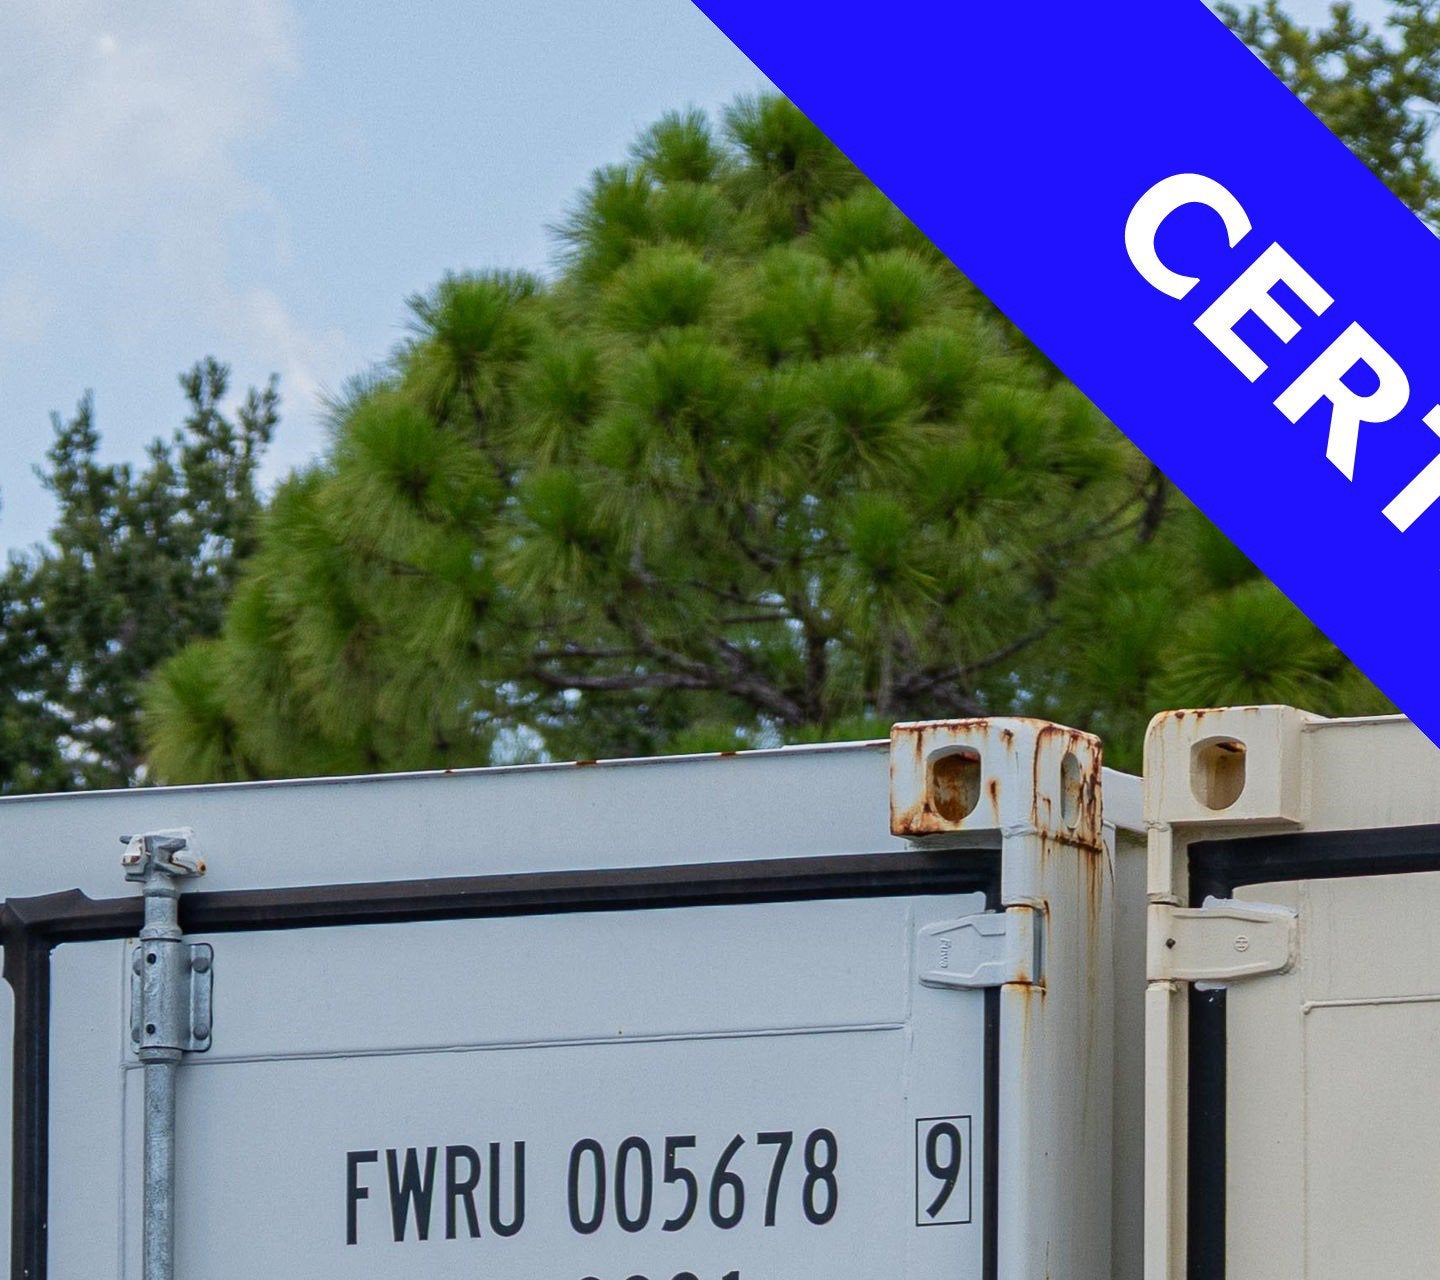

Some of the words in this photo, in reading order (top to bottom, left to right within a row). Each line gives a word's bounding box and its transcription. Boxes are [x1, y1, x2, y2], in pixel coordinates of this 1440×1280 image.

[347, 1141, 526, 1246] FWRU
[568, 1129, 839, 1235] 005678
[926, 1122, 962, 1219] 9
